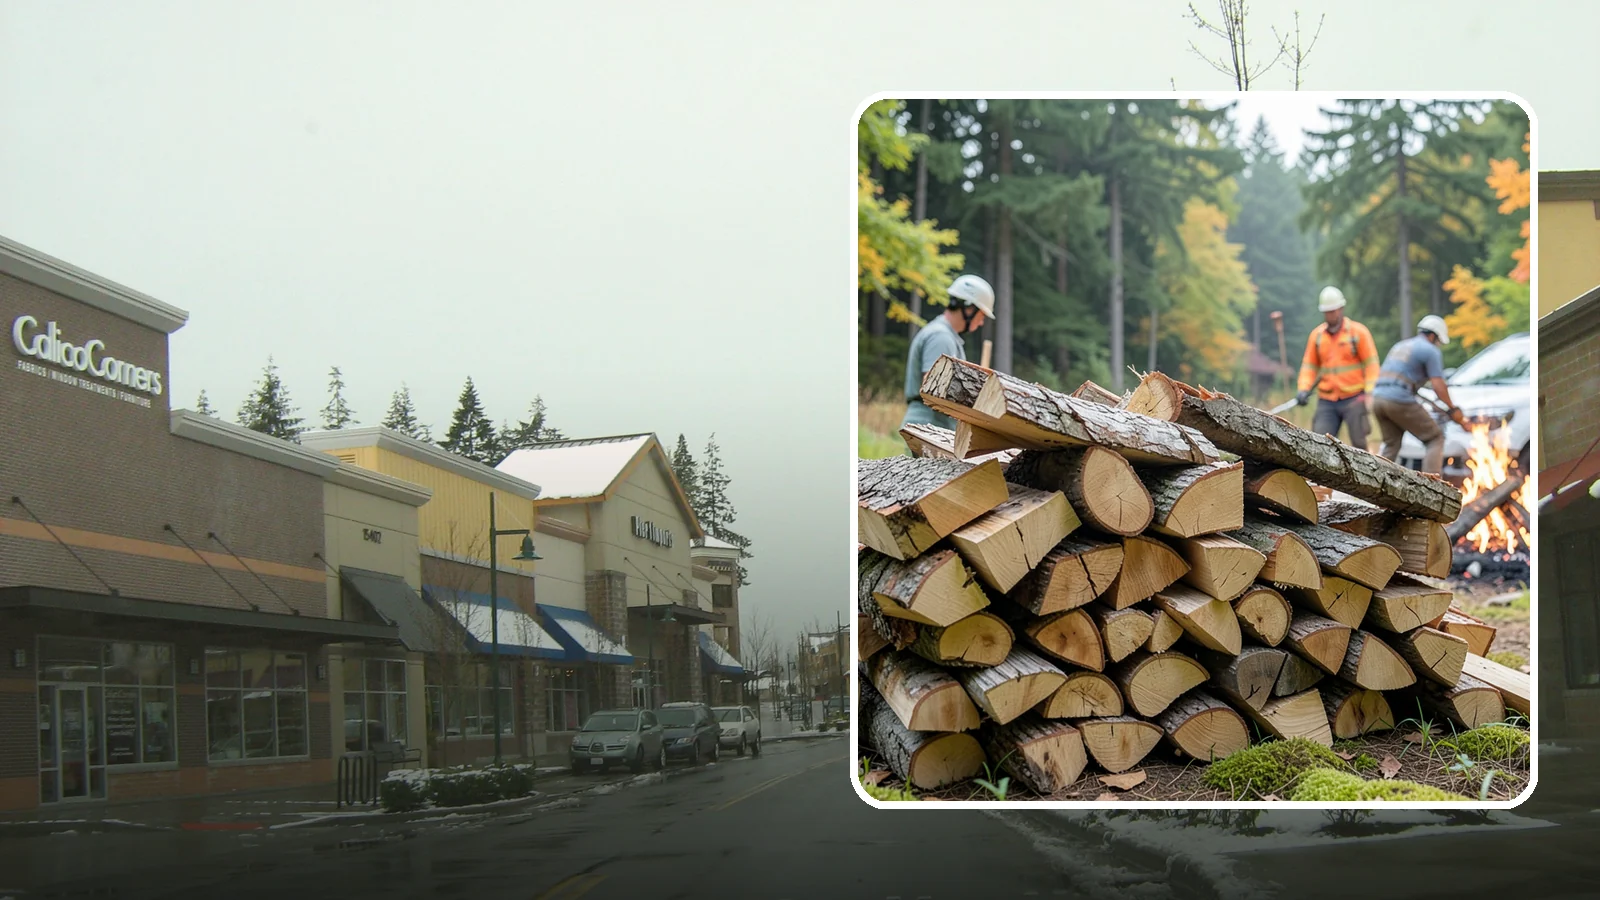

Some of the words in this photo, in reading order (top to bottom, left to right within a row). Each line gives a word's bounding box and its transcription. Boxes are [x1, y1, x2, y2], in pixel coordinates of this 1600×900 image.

[17, 360, 47, 377] FABRICS
[51, 371, 78, 386] WINDOW
[78, 378, 117, 398] TREATMENTS
[120, 391, 152, 409] FURNITURE
